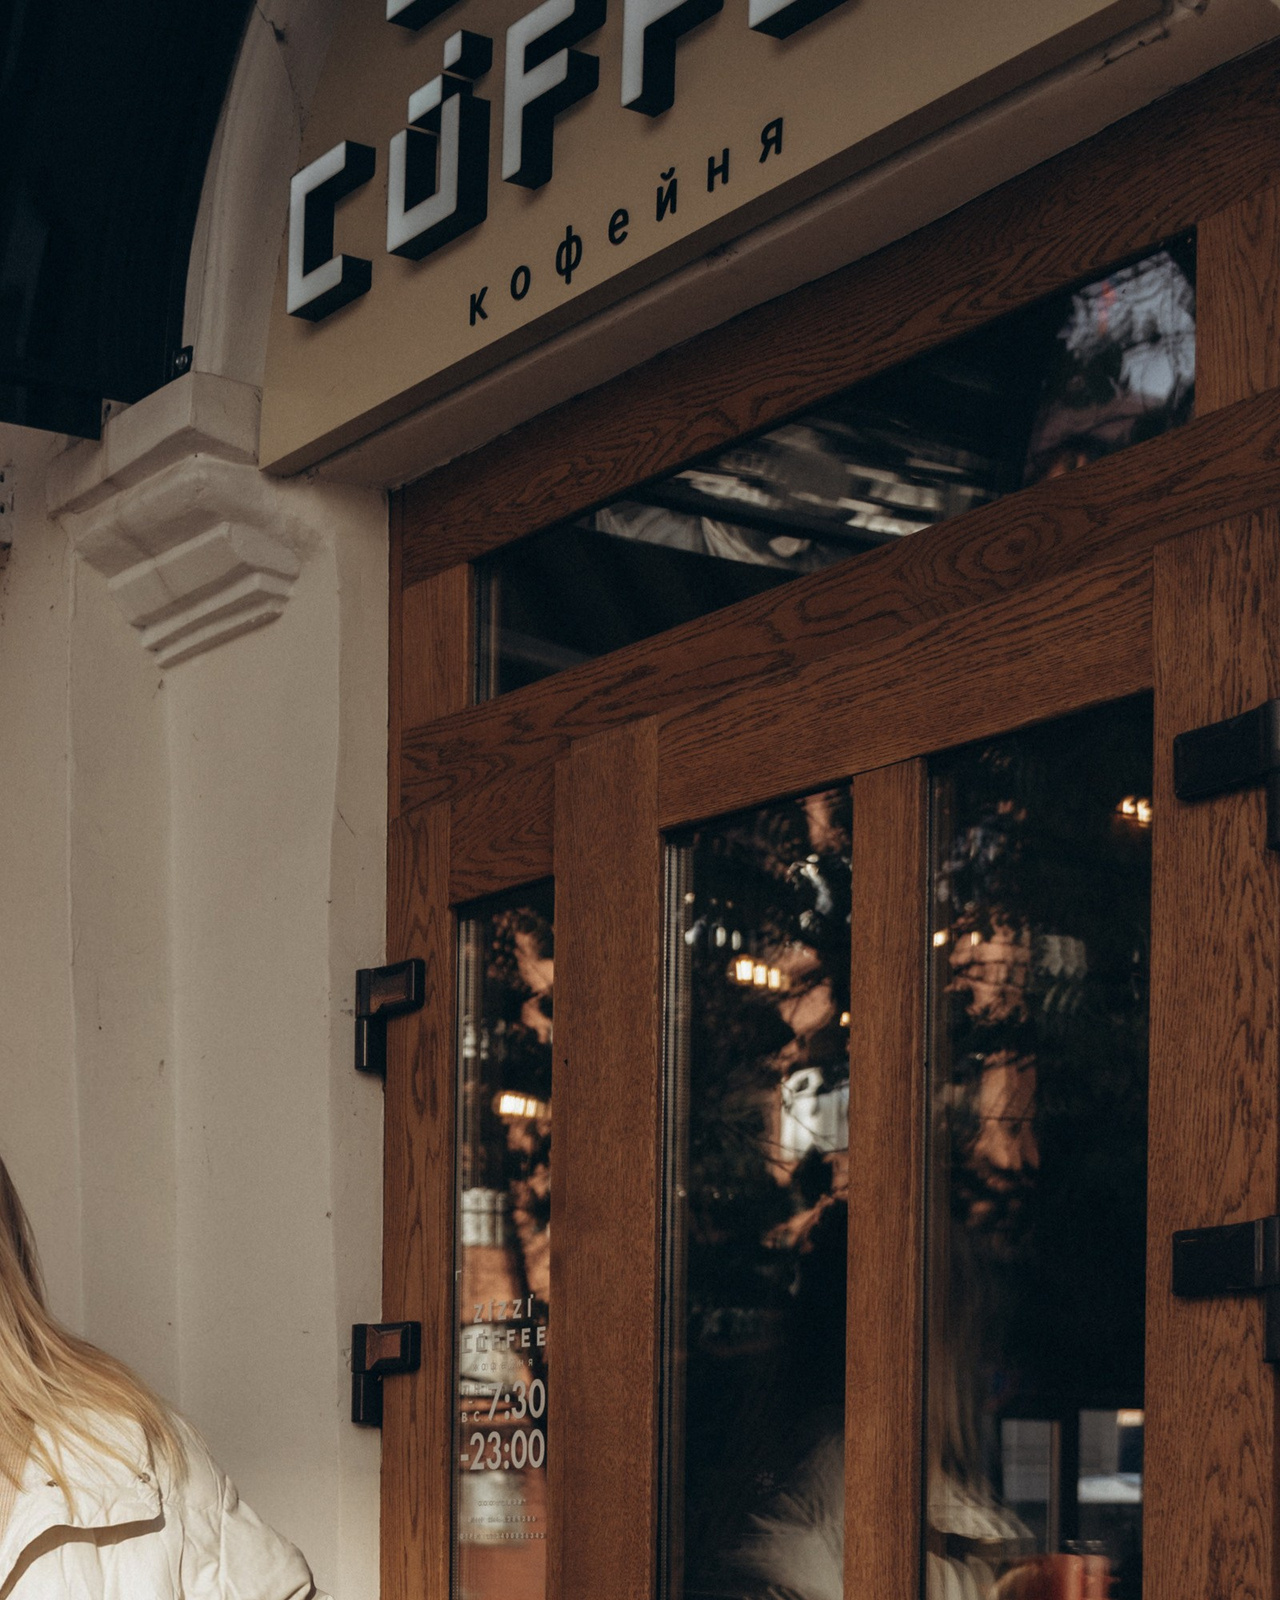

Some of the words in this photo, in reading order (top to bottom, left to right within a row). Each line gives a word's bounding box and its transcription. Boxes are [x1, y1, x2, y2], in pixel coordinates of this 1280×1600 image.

[469, 116, 785, 327] кофейня
[462, 1326, 547, 1352] COFFEE
[487, 1378, 546, 1421] 7:30
